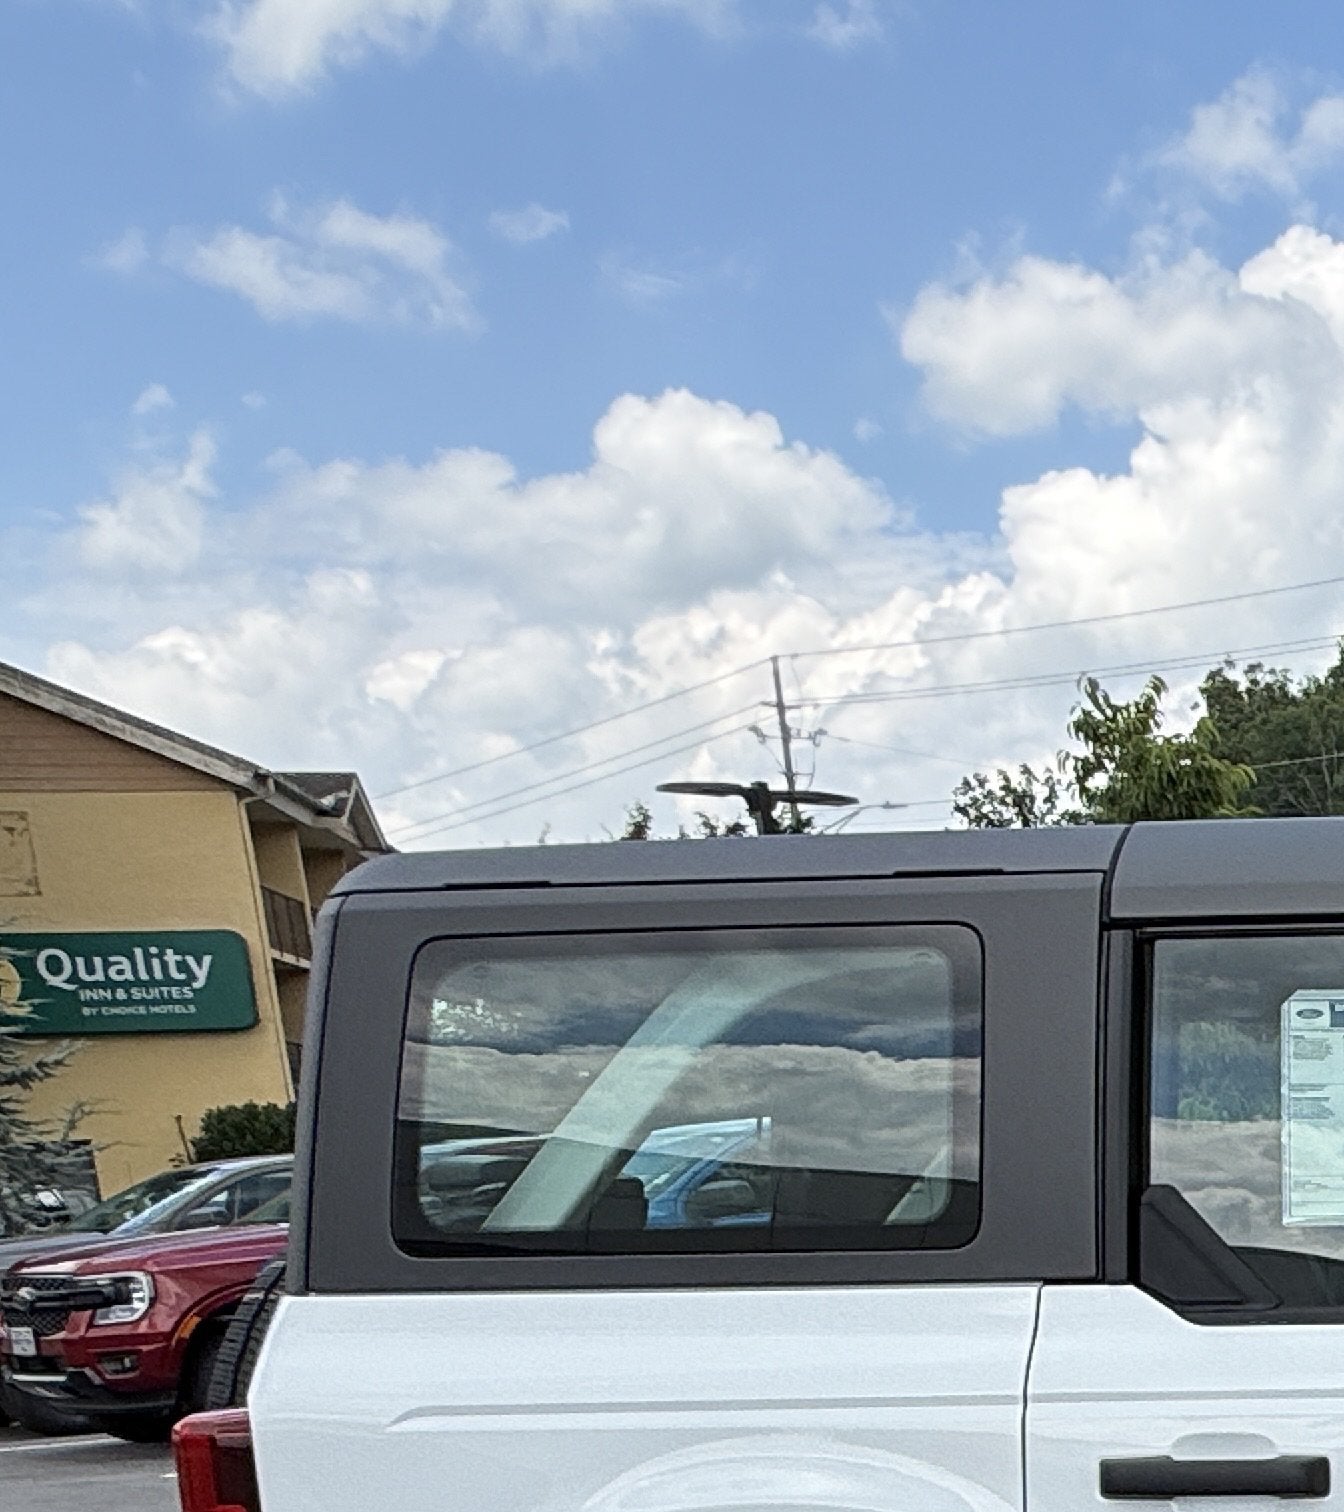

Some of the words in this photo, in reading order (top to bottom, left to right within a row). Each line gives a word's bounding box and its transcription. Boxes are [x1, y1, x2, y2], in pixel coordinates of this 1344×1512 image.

[36, 946, 213, 990] Quality
[79, 988, 112, 1001] INN
[115, 988, 127, 1000] &
[130, 986, 194, 1000] SUITES
[82, 1005, 99, 1016] BY
[101, 1005, 147, 1015] CHOICE
[150, 1004, 196, 1014] HOTELS
